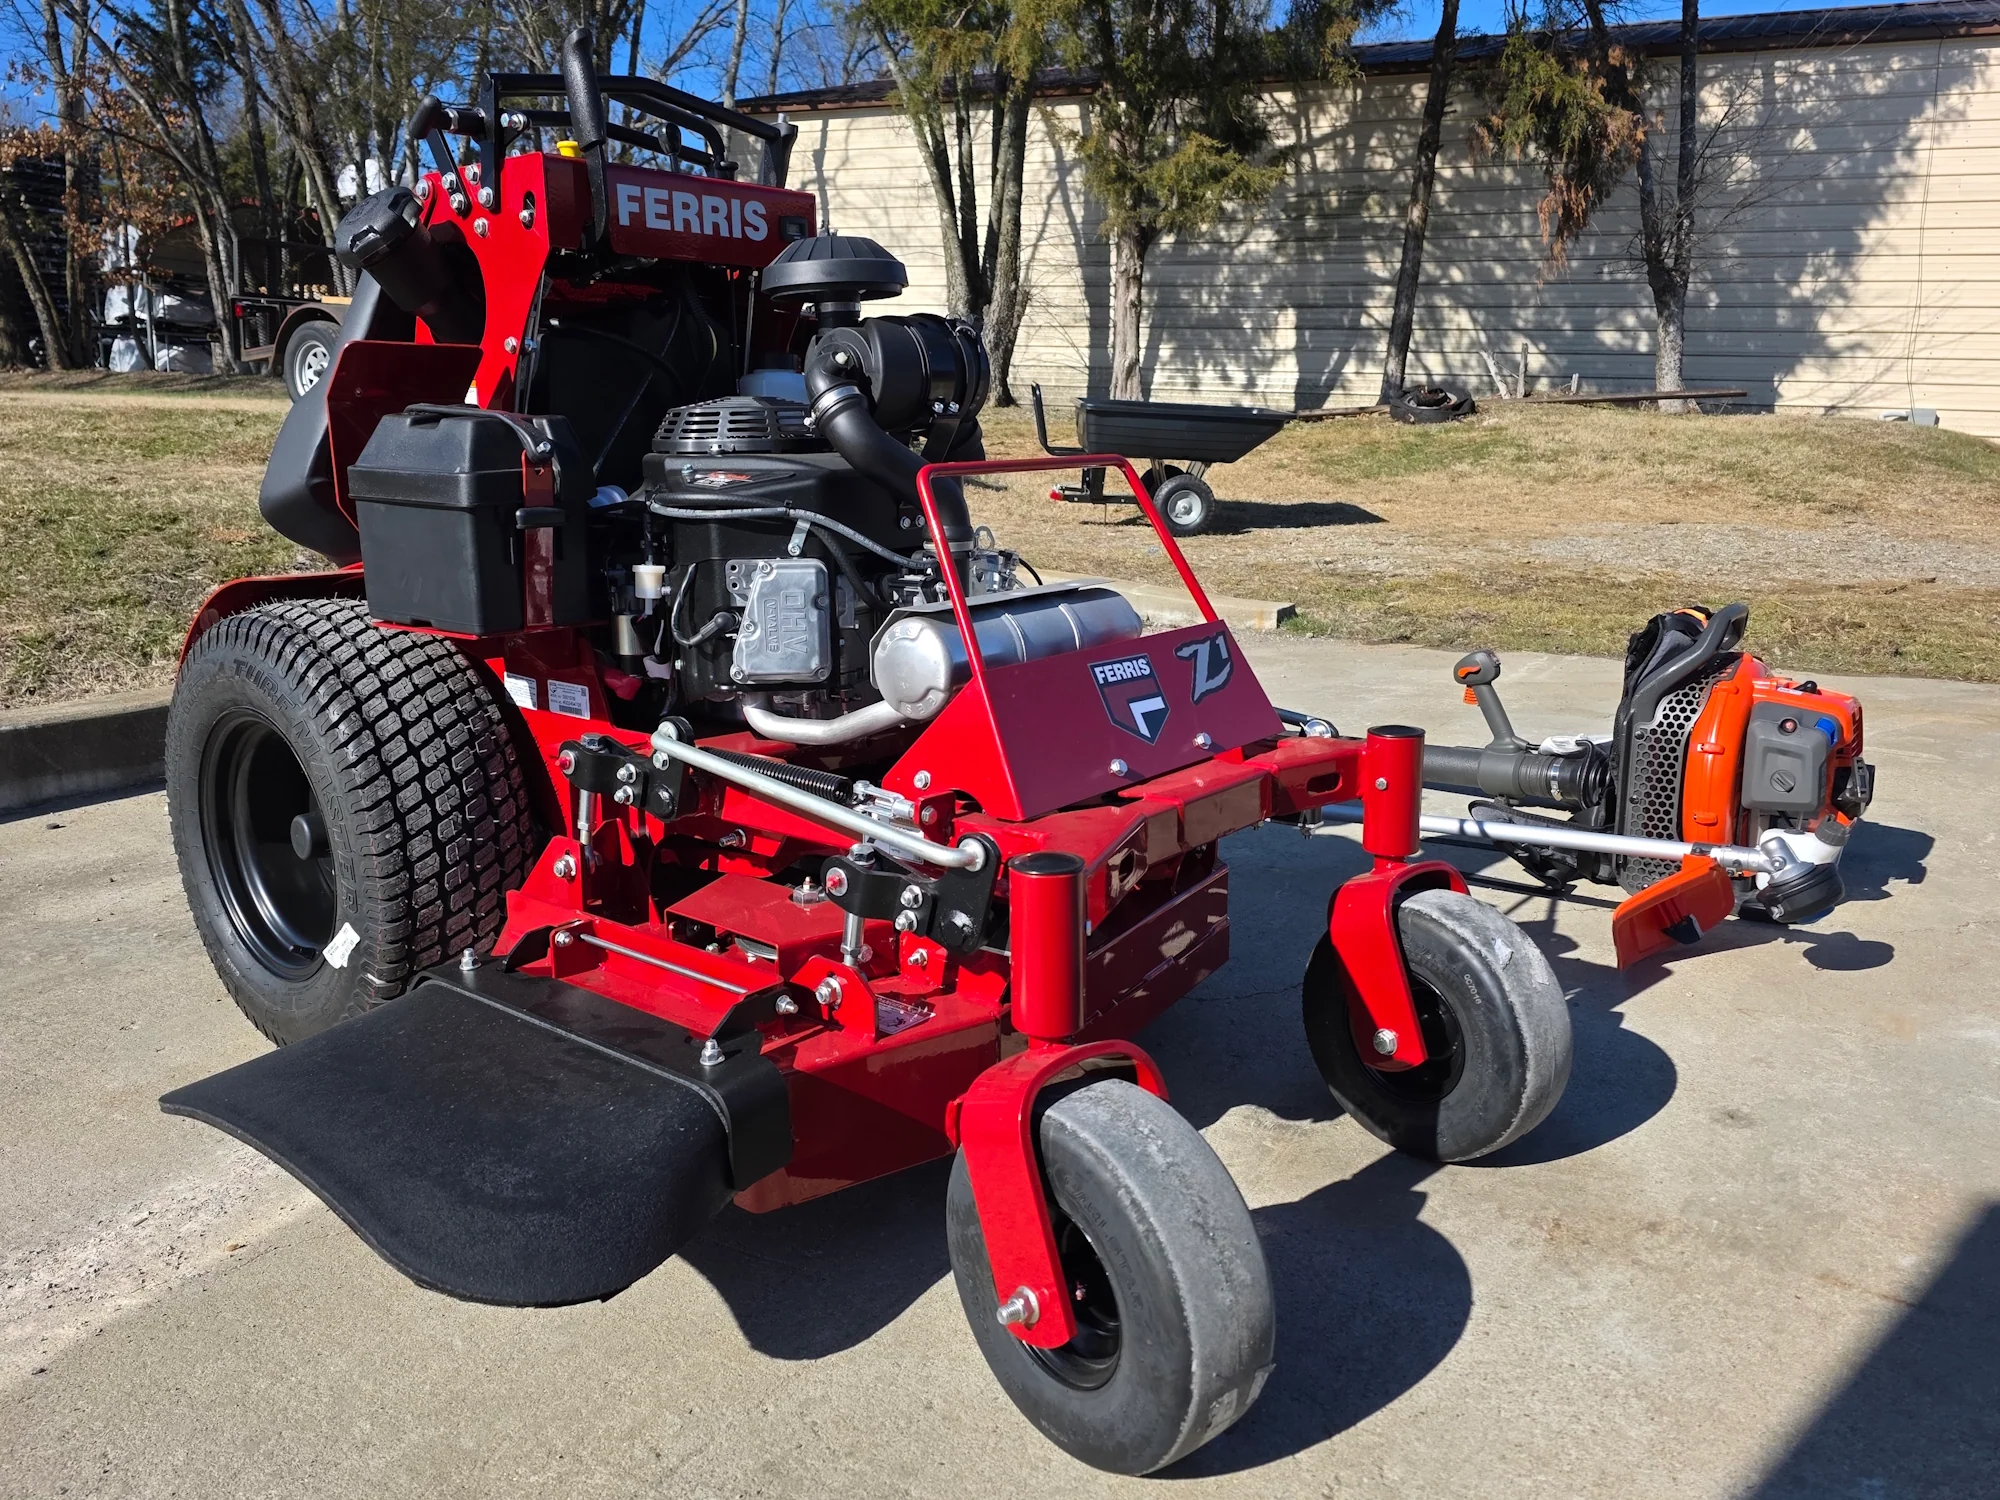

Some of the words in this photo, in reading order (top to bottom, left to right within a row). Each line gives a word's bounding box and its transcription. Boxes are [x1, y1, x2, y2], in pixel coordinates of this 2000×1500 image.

[616, 183, 769, 242] FERRIS
[766, 601, 779, 652] V-VALVE
[780, 590, 808, 654] OHV
[1094, 657, 1151, 685] FERRIS
[1176, 635, 1232, 701] Z1
[233, 658, 296, 712] TURF
[292, 718, 359, 915] MASTER
